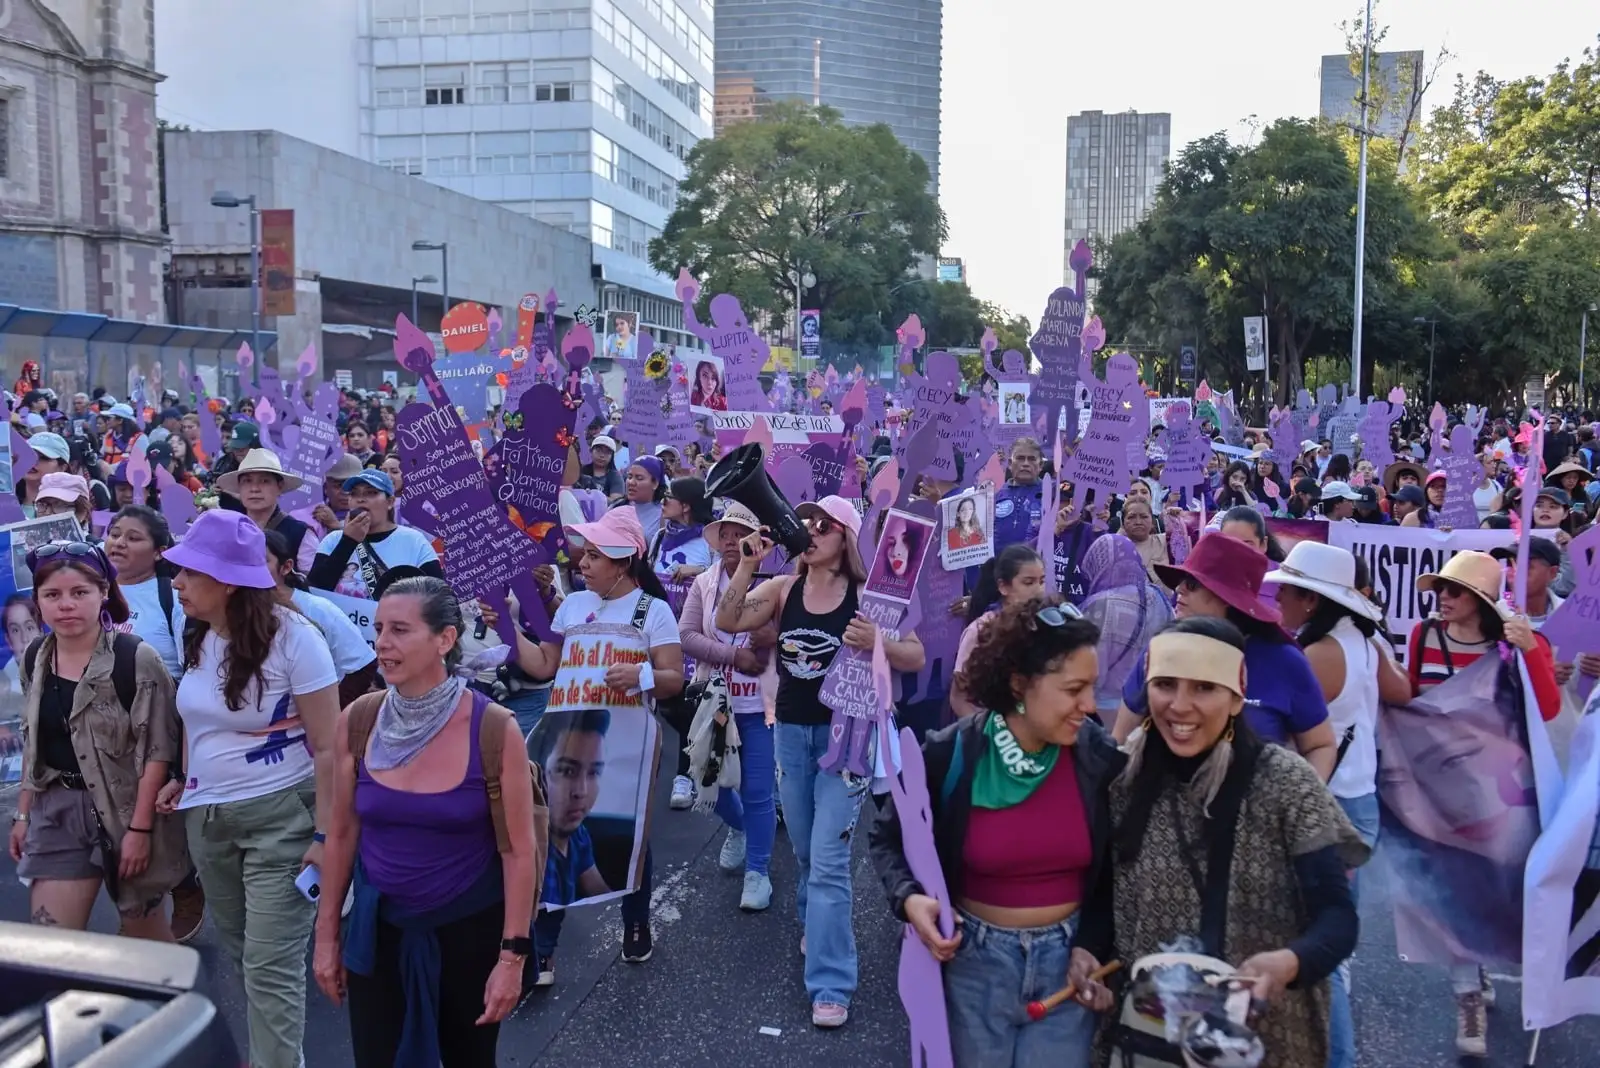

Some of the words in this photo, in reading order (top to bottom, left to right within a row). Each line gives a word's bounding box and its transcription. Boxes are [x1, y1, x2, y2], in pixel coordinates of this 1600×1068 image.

[1049, 299, 1085, 317] YOLANDA
[442, 323, 487, 337] DANIEL
[711, 331, 750, 350] LUPITA
[724, 354, 743, 366] IVE
[917, 386, 953, 406] CECY
[1094, 386, 1124, 401] CECY
[712, 410, 752, 429] Somos
[791, 414, 807, 430] de
[425, 450, 445, 463] Soto
[1352, 542, 1459, 620] USTICI
[587, 641, 601, 667] al
[567, 677, 580, 706] de
[834, 681, 880, 706] CALVO
[993, 729, 1031, 775] DIOS
